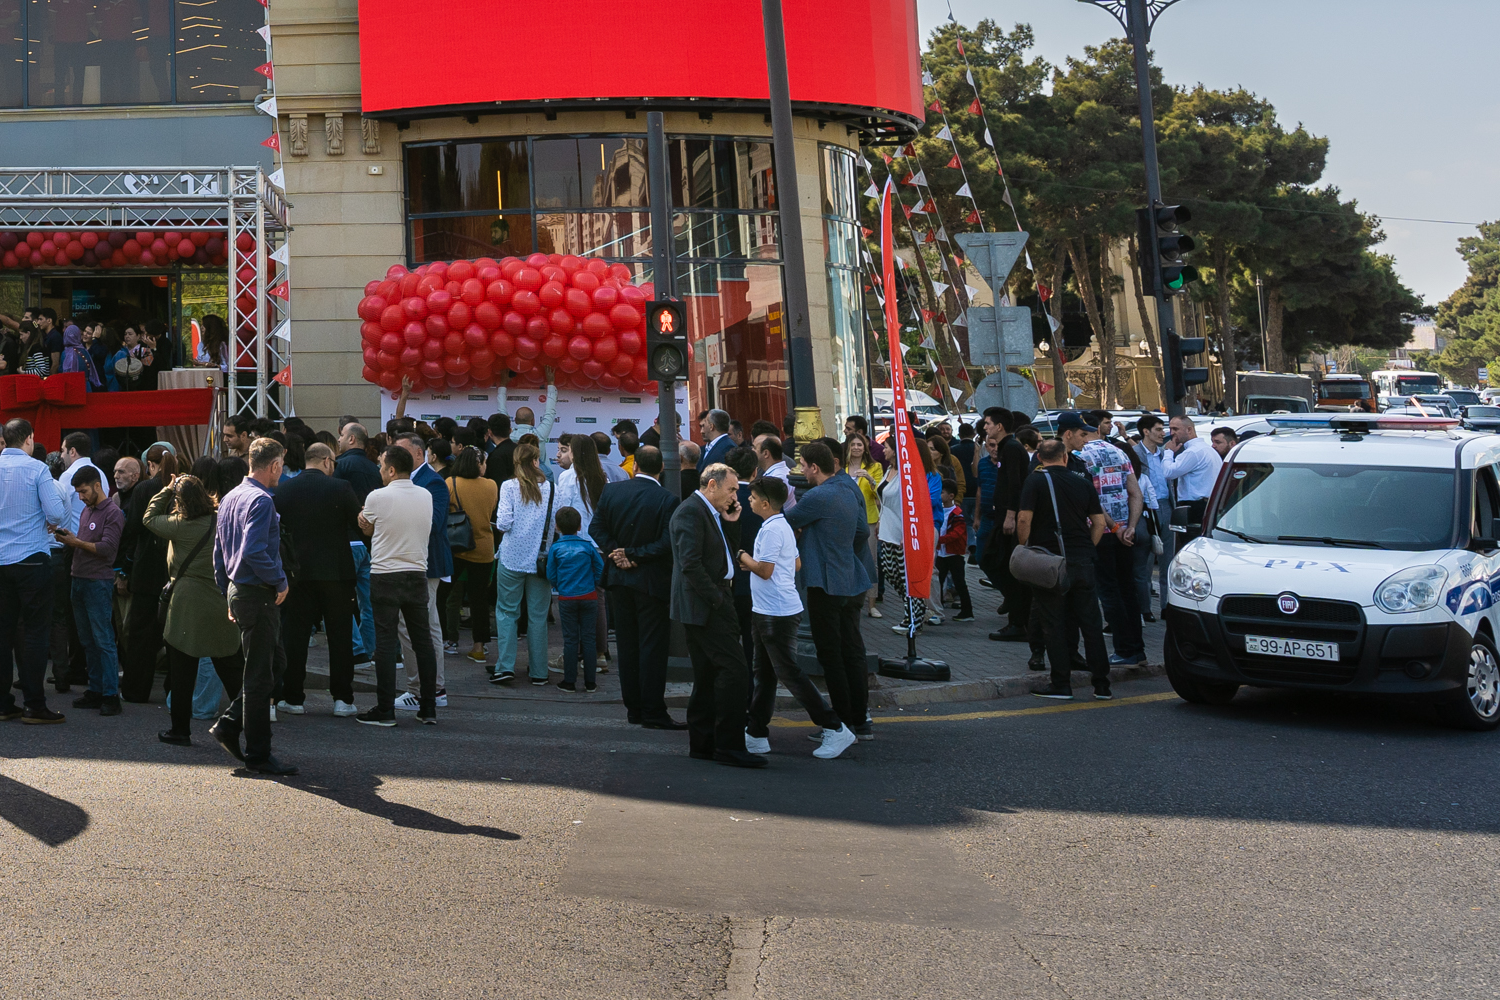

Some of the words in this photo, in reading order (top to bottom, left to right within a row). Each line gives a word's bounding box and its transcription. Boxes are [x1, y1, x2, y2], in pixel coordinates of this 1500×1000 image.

[897, 407, 920, 551] Electronics
[1264, 559, 1352, 573] PPX
[1282, 600, 1295, 610] FIAT
[1259, 638, 1335, 660] 99-AP-651
